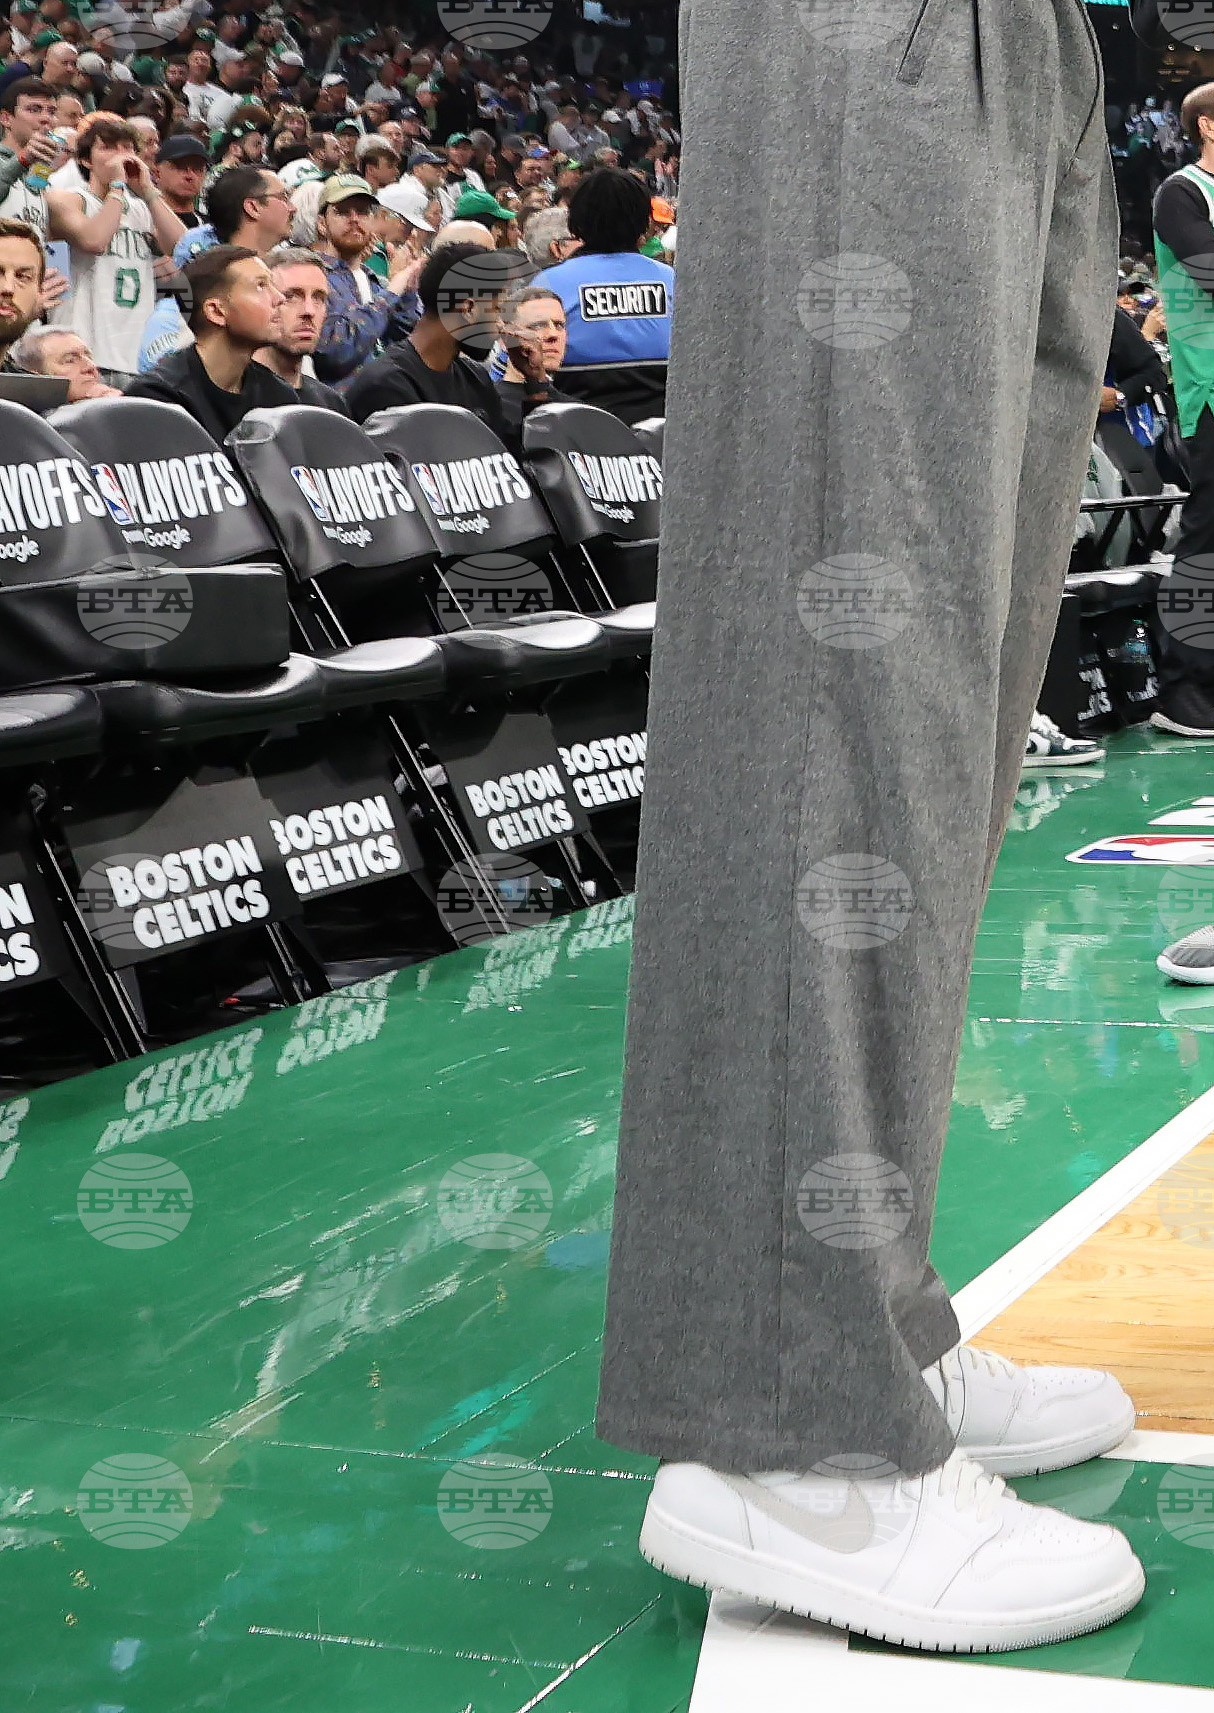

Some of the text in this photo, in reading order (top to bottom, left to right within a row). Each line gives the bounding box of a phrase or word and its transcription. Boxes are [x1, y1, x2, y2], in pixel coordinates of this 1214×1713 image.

[584, 285, 663, 316] SECURITY
[114, 451, 248, 525] PLAYOFFS
[309, 460, 416, 524] PLAYOFFS
[428, 451, 532, 515] PLAYOFFS
[144, 523, 193, 550] Google
[336, 524, 374, 548] Google
[453, 513, 491, 535] Google
[464, 763, 566, 818] BOSTON
[486, 798, 575, 851] CELTICS
[104, 834, 264, 908] BOSTON
[284, 833, 402, 895] CELTICS
[132, 878, 271, 949] CELTICS
